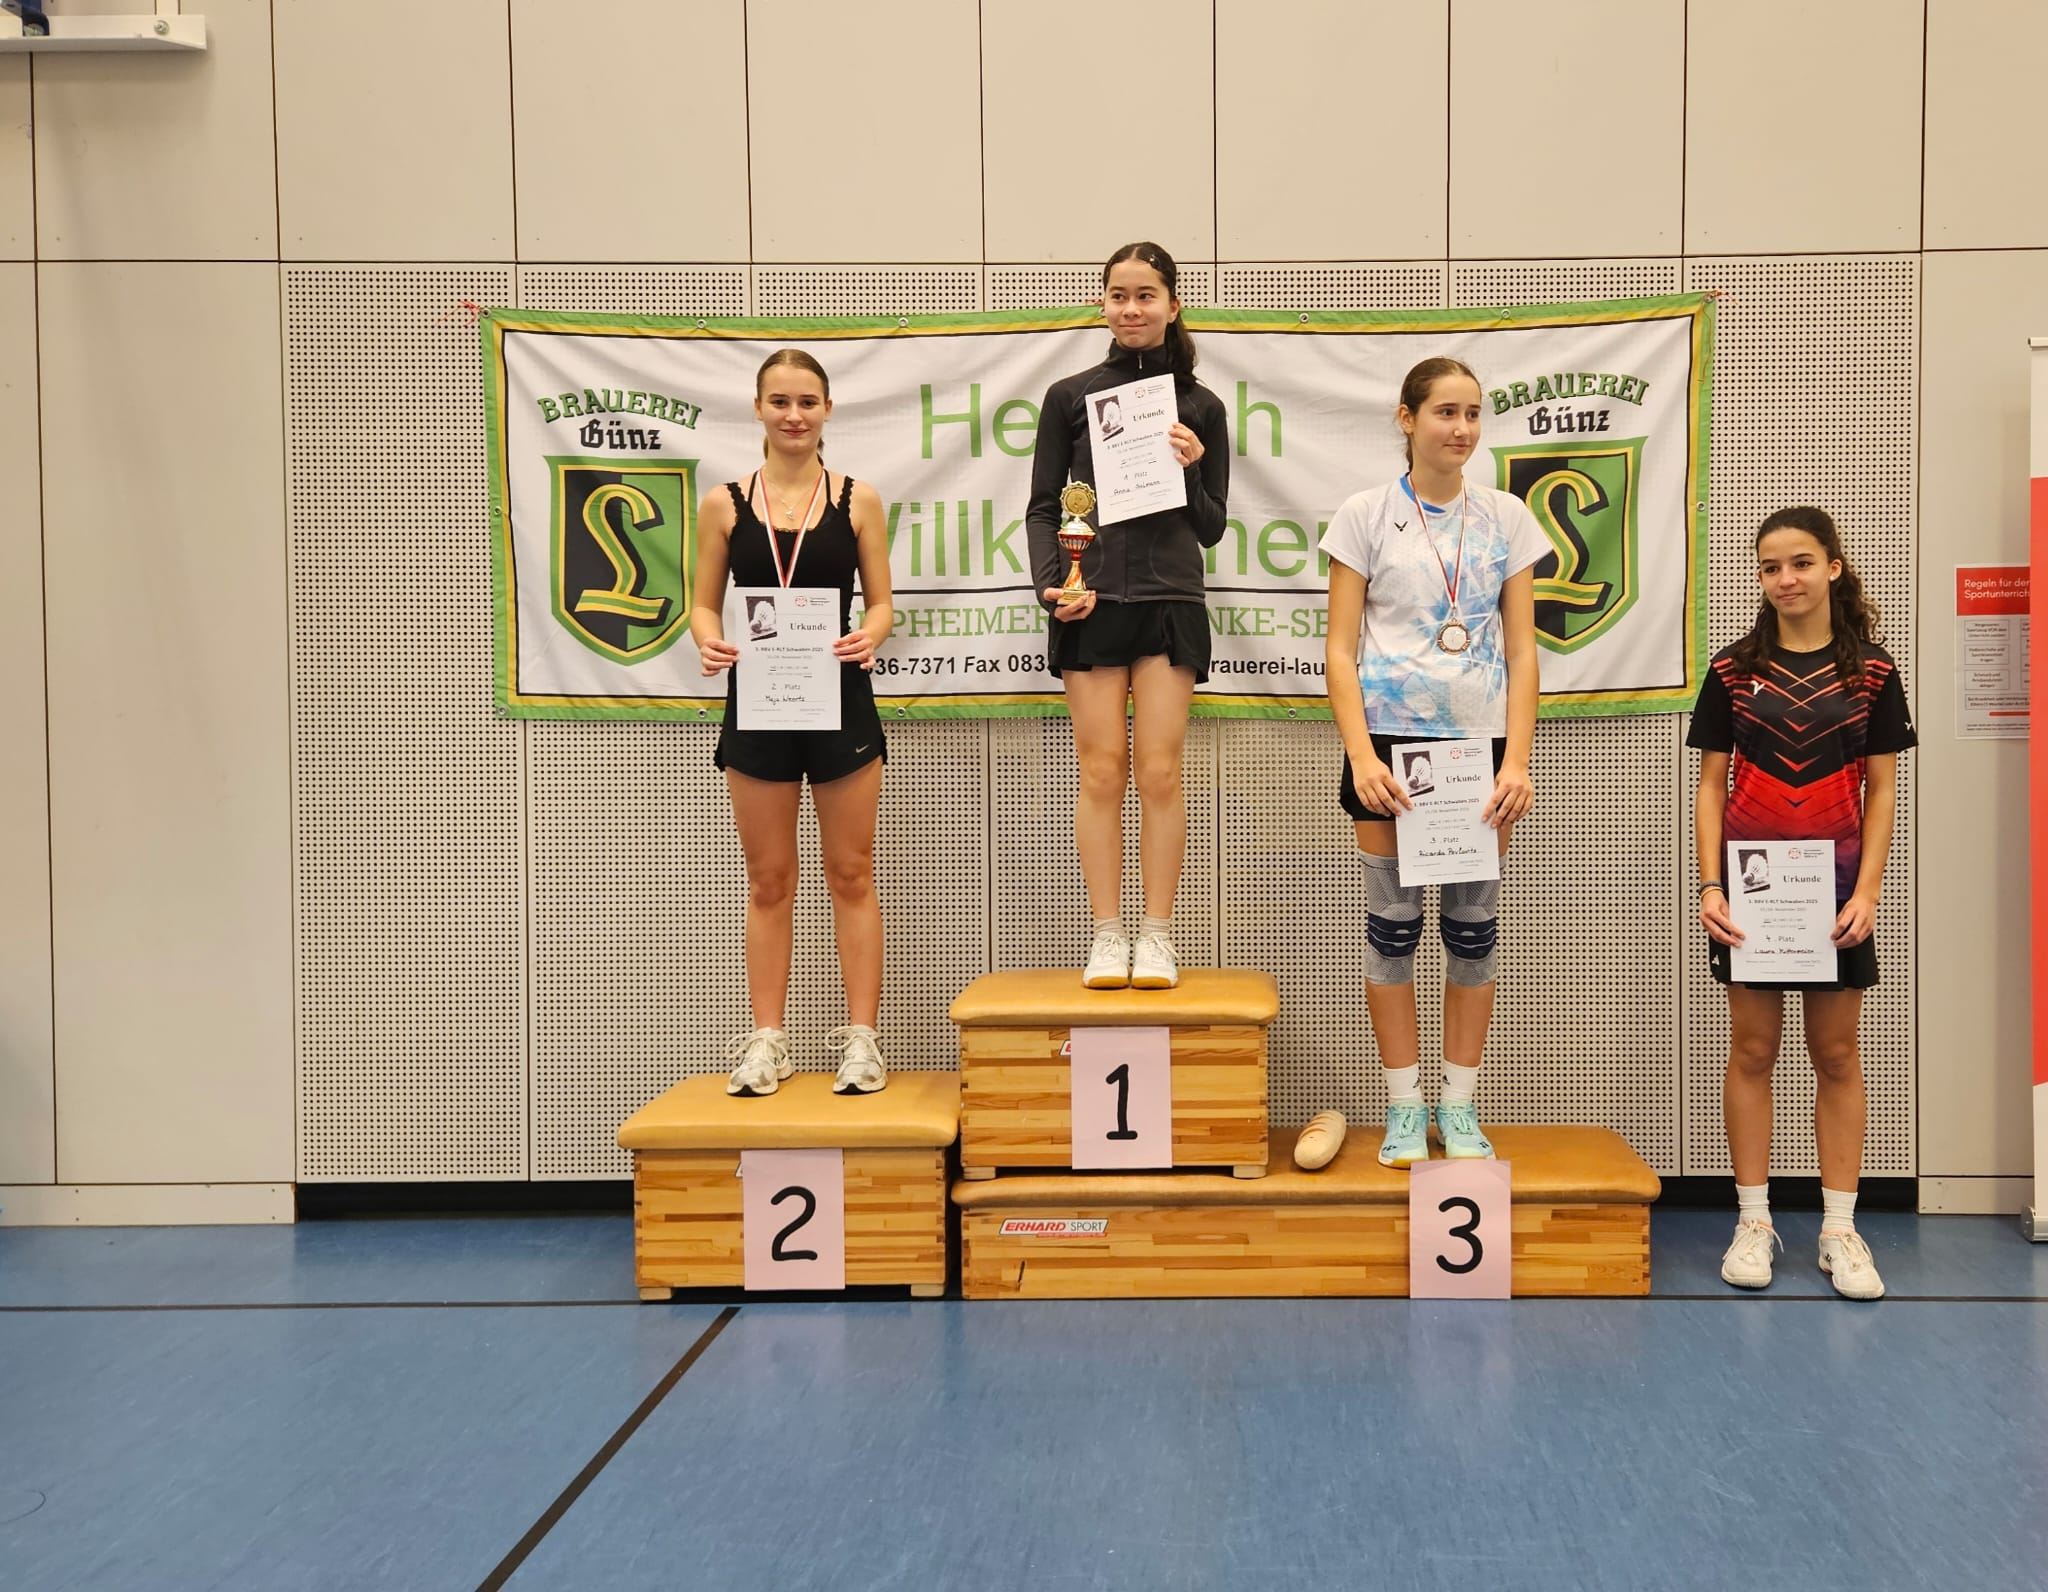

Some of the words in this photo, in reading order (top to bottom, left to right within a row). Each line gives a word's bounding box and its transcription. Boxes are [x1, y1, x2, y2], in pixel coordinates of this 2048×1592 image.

[1488, 372, 1650, 415] BRAUEREI
[537, 389, 702, 430] BRAUEREI
[1133, 409, 1166, 422] Urkunde
[1528, 406, 1610, 436] Günz
[579, 418, 662, 450] Günz
[1964, 577, 1997, 590] Regeln
[1999, 577, 2012, 588] für
[1964, 588, 2031, 600] Sportunterrich
[790, 622, 828, 631] Urkunde
[872, 656, 956, 675] 36-7371
[963, 656, 1001, 673] Fax
[1007, 654, 1050, 673] 083
[1210, 657, 1325, 676] rauerei-lau
[1446, 774, 1482, 783] Urkunde
[1783, 875, 1822, 883] Urkunde
[1106, 1063, 1138, 1140] 1
[770, 1185, 818, 1262] 2
[1004, 1221, 1067, 1232] ERHARD
[1070, 1221, 1103, 1232] SPORT
[1436, 1196, 1484, 1275] 3
